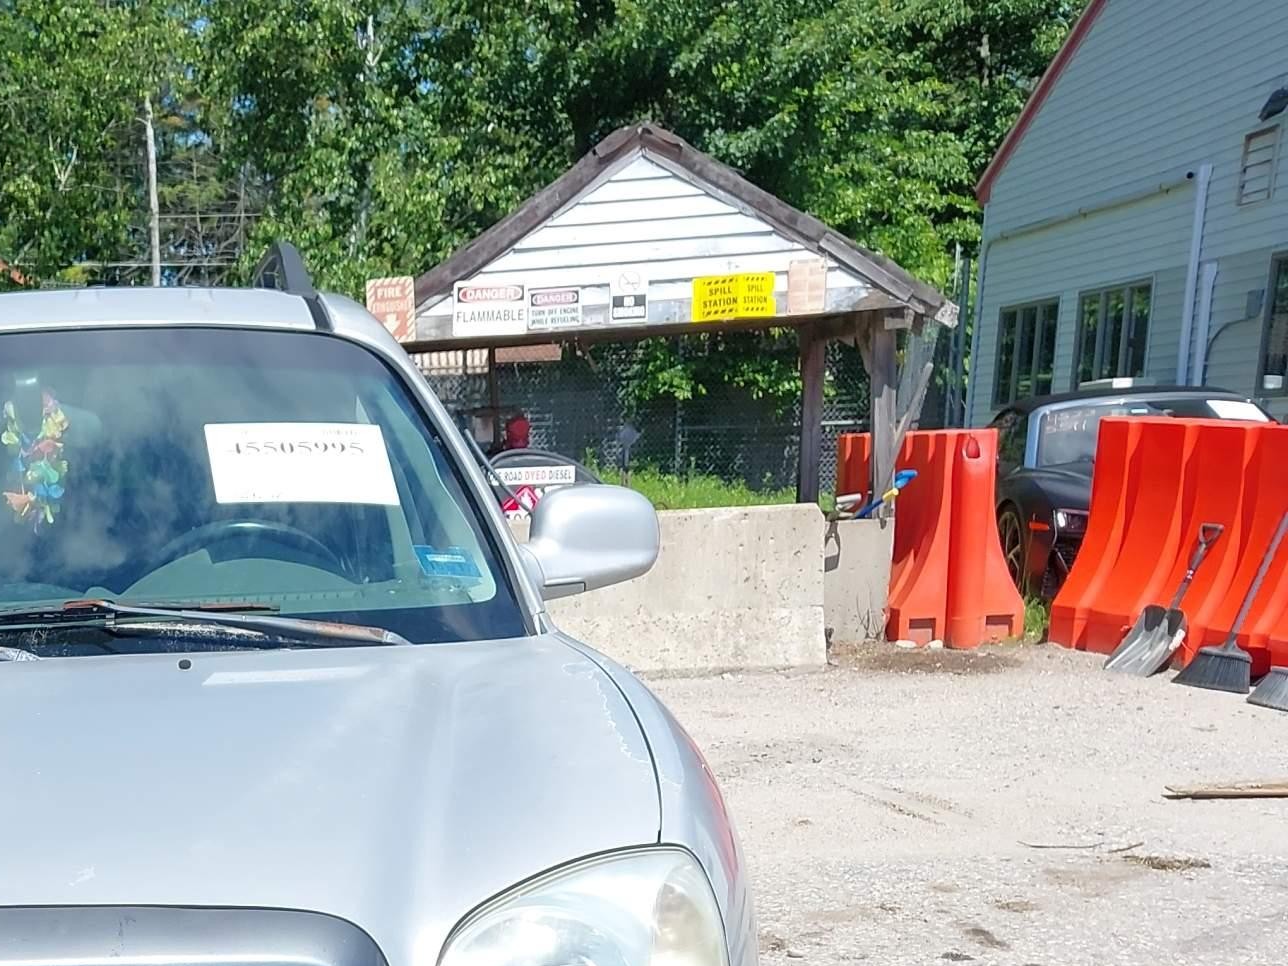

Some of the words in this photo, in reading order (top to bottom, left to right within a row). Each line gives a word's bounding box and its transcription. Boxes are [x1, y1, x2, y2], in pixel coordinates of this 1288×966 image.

[376, 286, 402, 299] FIRE
[465, 287, 516, 300] DANGER
[708, 286, 733, 296] SPILL
[747, 284, 764, 293] SPILL
[536, 291, 573, 305] DANGER
[702, 296, 739, 308] STATION
[743, 295, 768, 304] STATION
[455, 308, 525, 324] FLAMMABLE
[504, 472, 523, 481] ROAD
[525, 470, 546, 481] DYED
[548, 468, 572, 480] DIESEL
